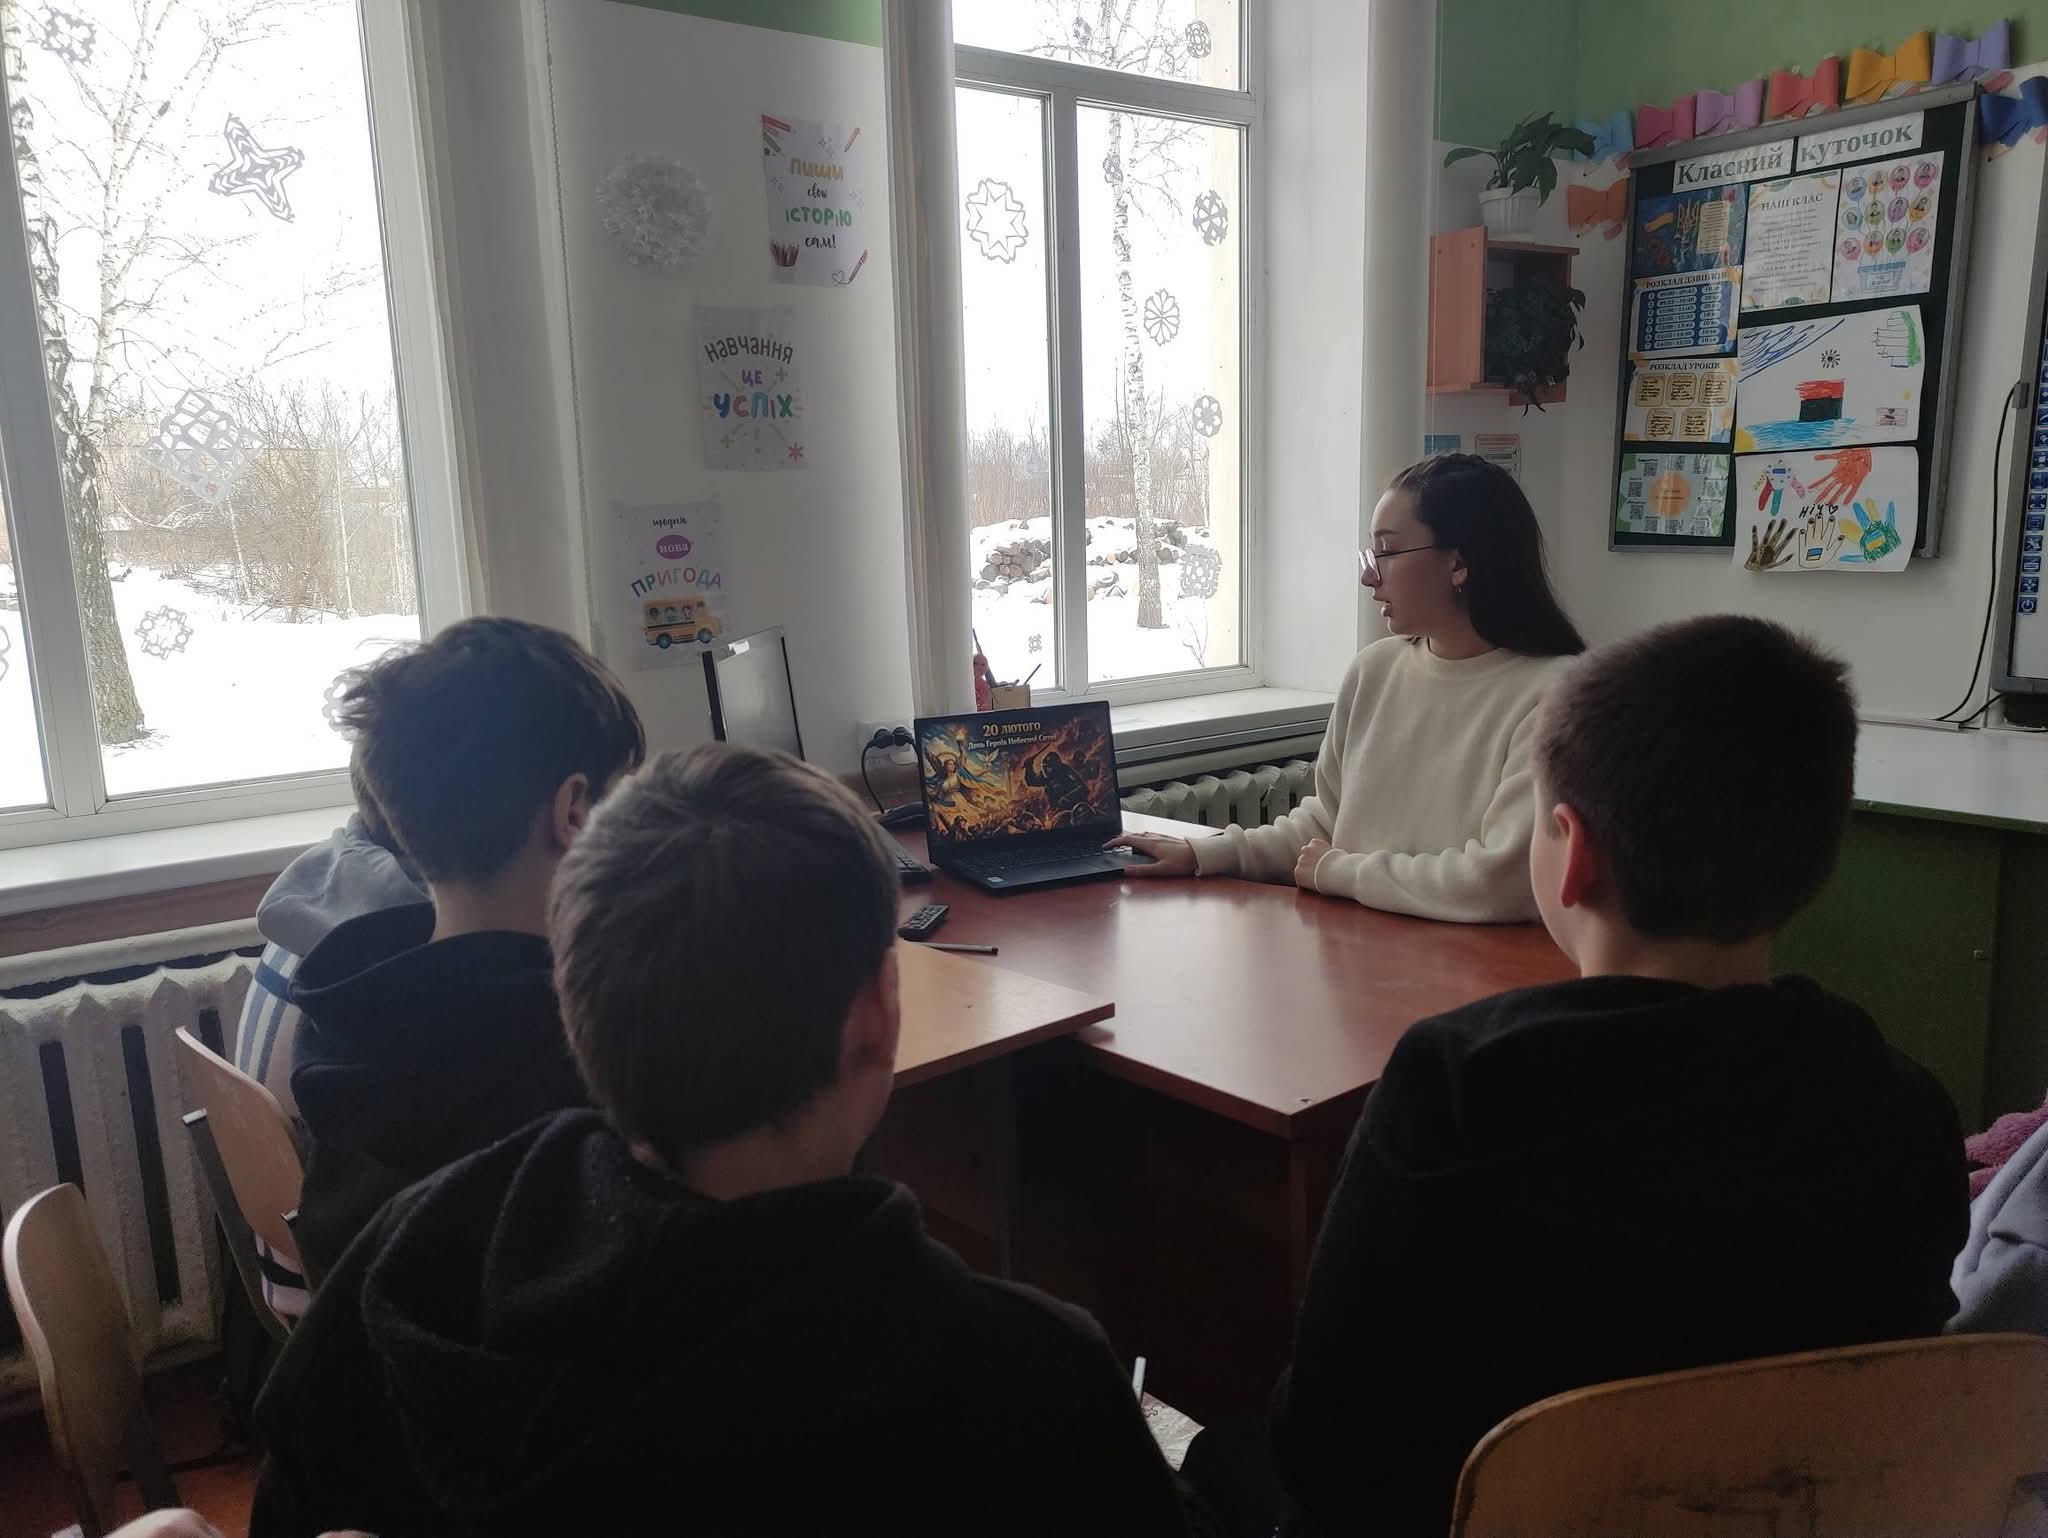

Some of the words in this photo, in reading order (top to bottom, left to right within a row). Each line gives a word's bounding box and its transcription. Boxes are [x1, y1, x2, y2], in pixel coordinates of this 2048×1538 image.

[1676, 145, 1783, 185] Класний
[1800, 124, 1914, 166] куточок
[1761, 197, 1790, 211] НАШ
[1791, 193, 1824, 206] КЛАС
[785, 206, 852, 227] ІСТОРІЮ
[805, 234, 836, 249] сам!
[742, 369, 763, 387] ЦЕ
[713, 391, 793, 419] УСПІХ
[631, 567, 721, 598] ПРИГОДА
[983, 724, 999, 736] 20
[1000, 722, 1040, 734] лютого
